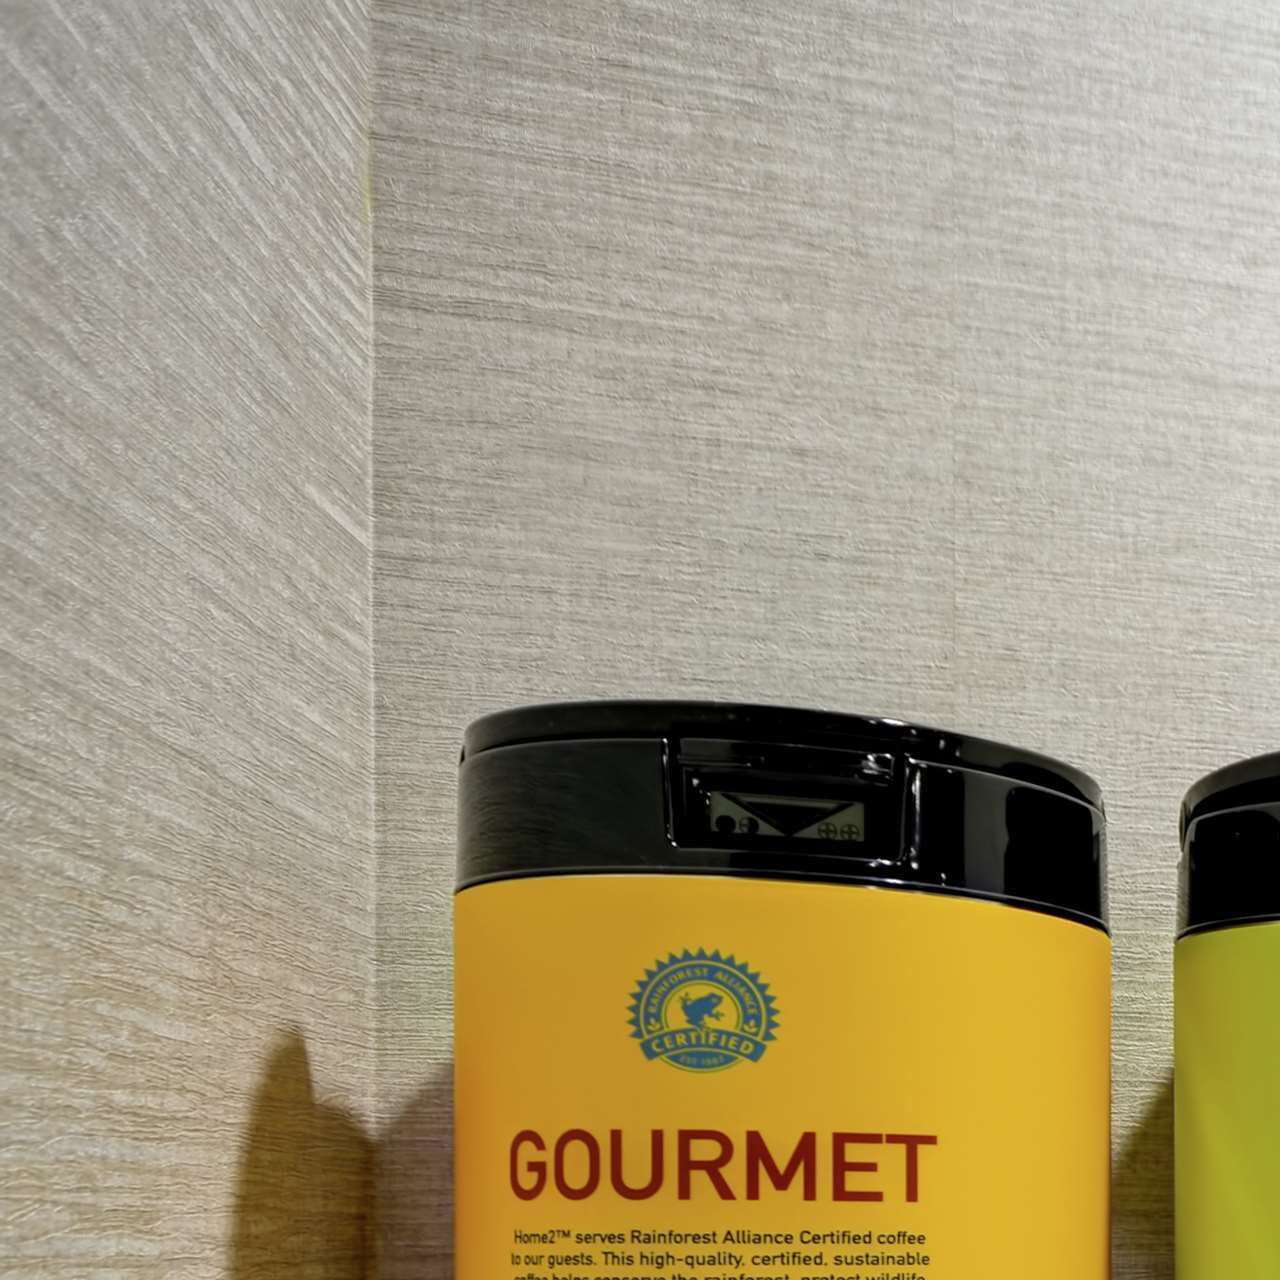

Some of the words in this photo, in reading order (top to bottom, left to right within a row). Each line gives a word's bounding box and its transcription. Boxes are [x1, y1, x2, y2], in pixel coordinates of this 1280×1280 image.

[651, 1032, 755, 1054] CERTIFIED
[509, 1128, 938, 1202] GOURMET
[575, 1232, 625, 1244] serves
[631, 1230, 717, 1244] Rainforest
[722, 1230, 794, 1244] Alliance
[800, 1230, 872, 1245] Certified
[877, 1231, 926, 1245] coffee
[524, 1255, 544, 1265] our
[548, 1253, 597, 1269] guests.
[603, 1252, 634, 1265] This
[833, 1252, 930, 1266] sustainable
